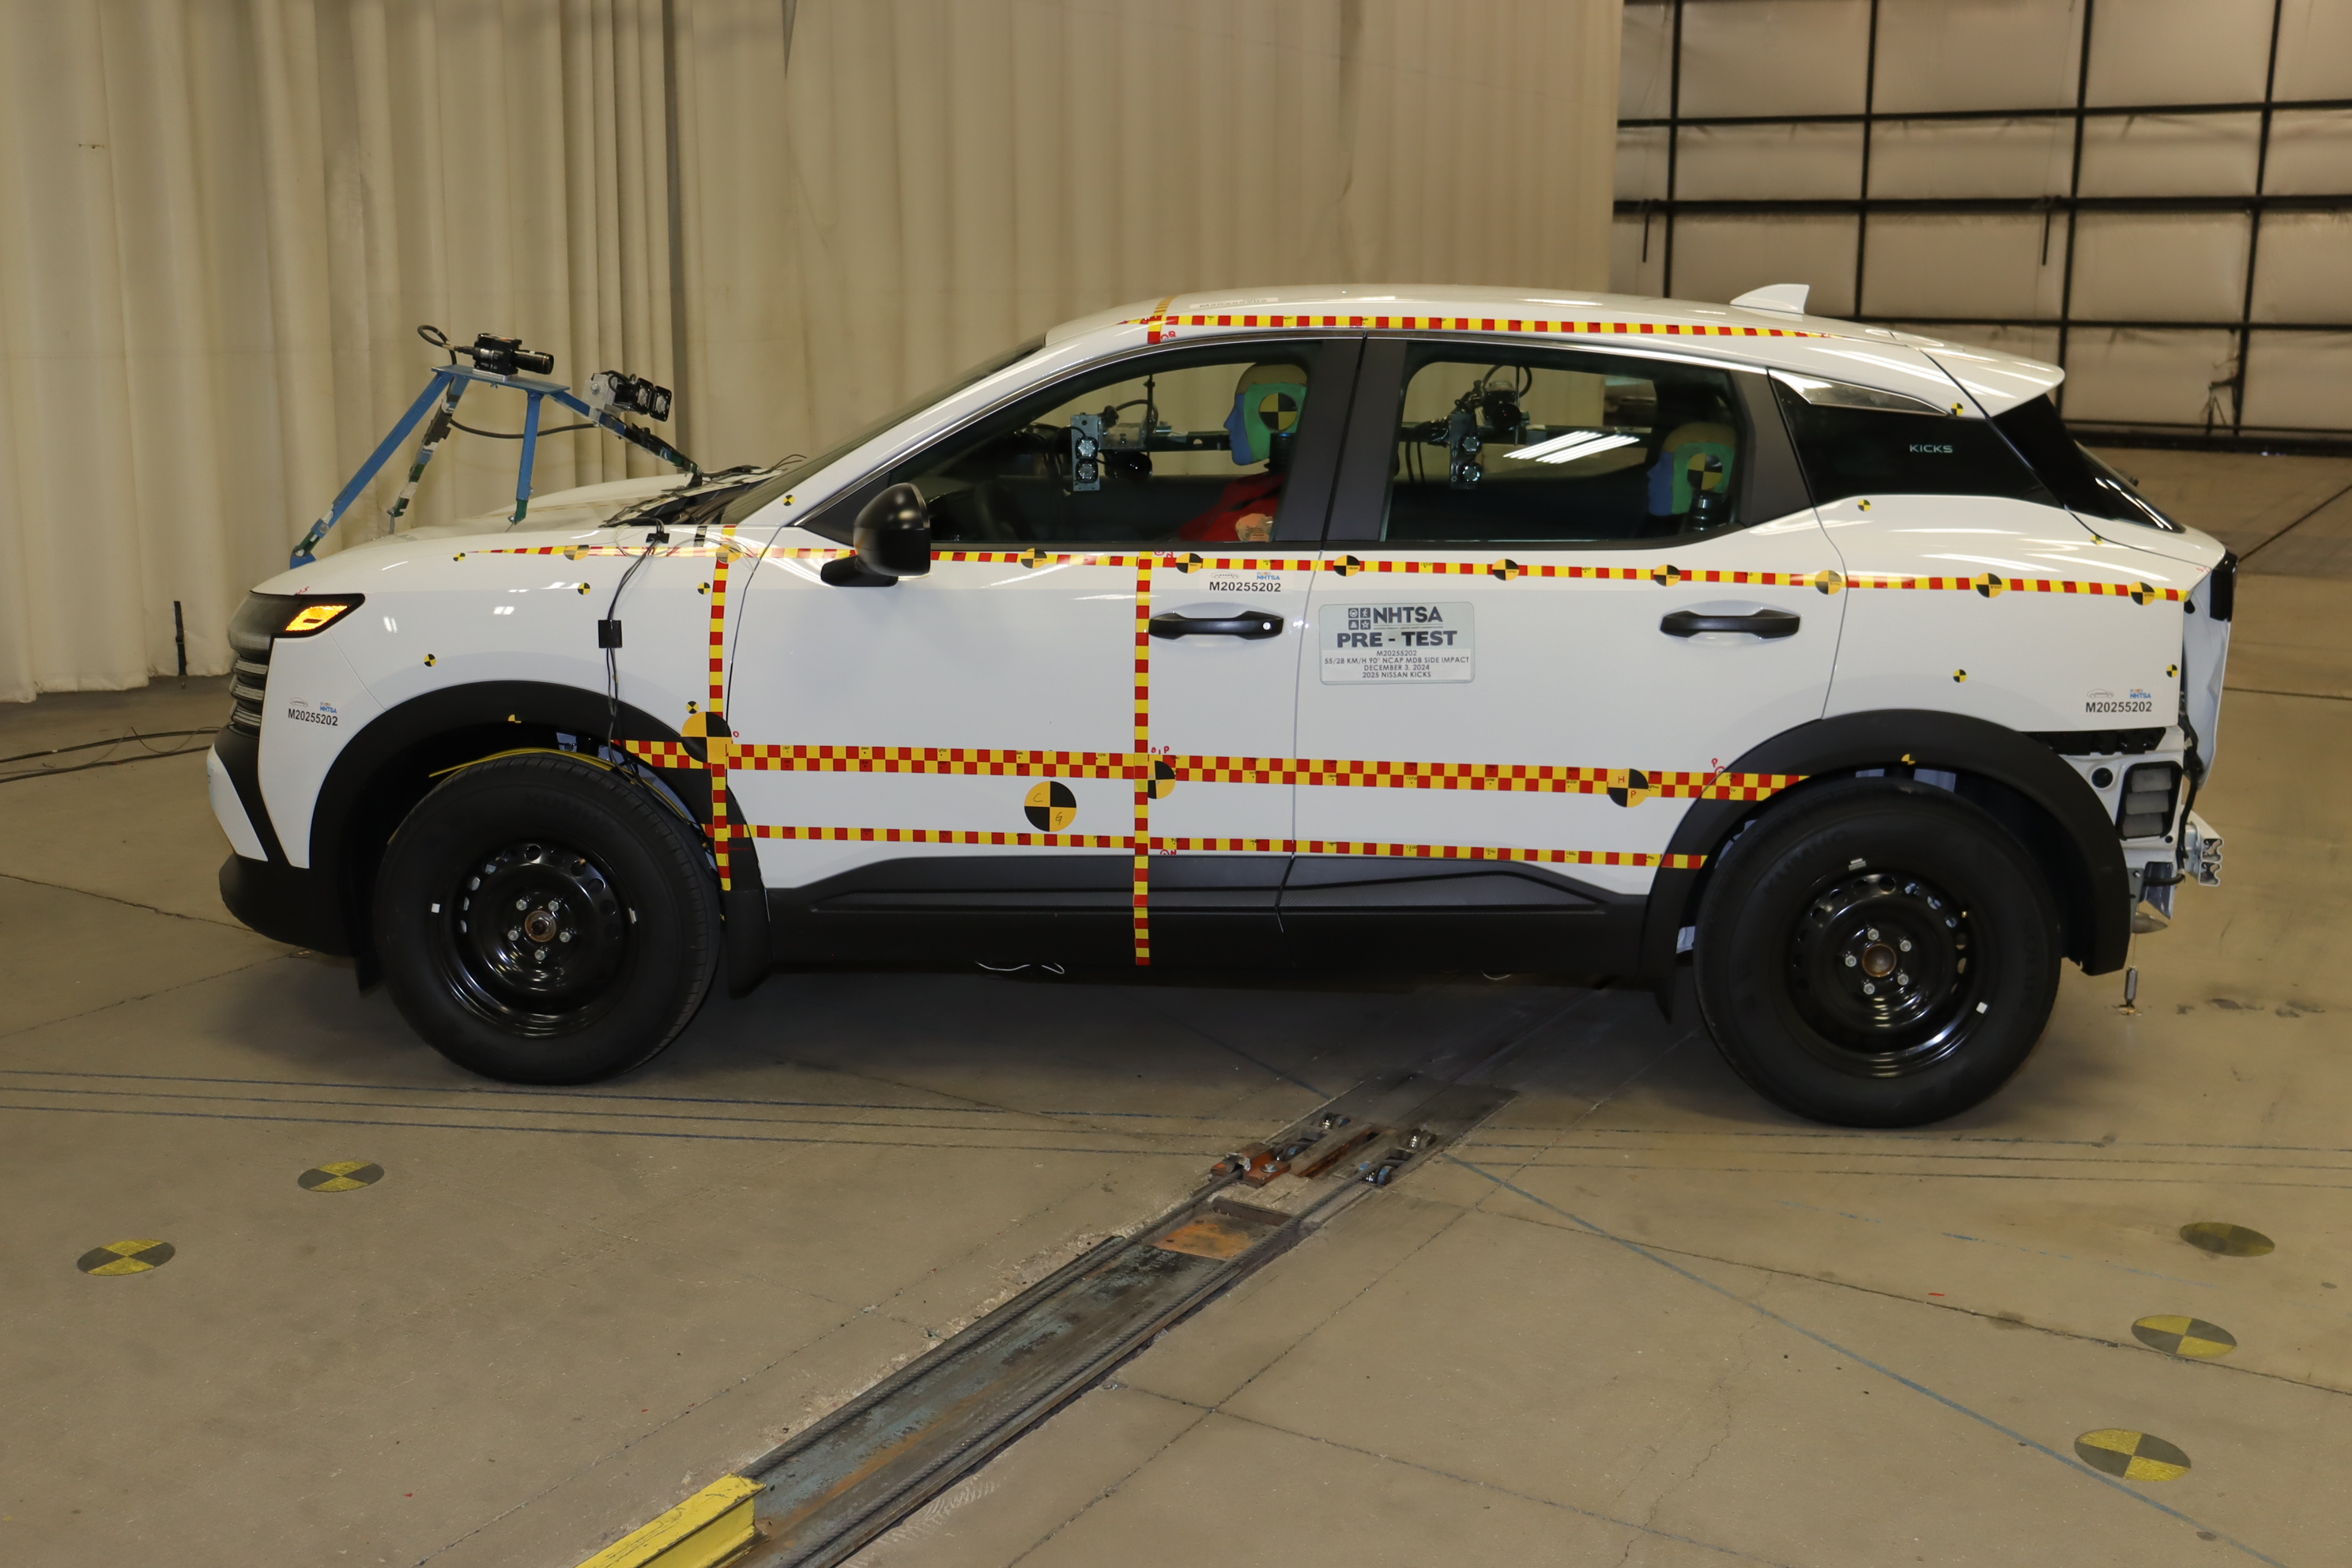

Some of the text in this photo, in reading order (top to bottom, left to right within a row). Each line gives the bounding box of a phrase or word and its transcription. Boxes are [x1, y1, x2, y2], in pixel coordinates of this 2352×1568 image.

[1909, 444, 1953, 453] KICKS
[1209, 582, 1281, 592] M20255202
[1373, 606, 1443, 624] NHTSA
[1337, 632, 1383, 648] PRE
[1401, 631, 1457, 646] TEST
[2086, 701, 2152, 713] M20255202
[288, 708, 338, 726] M20255202
[1032, 793, 1043, 803] C
[1630, 790, 1637, 799] P
[524, 792, 616, 836] KUMHO
[1762, 829, 1849, 895] KUMHO
